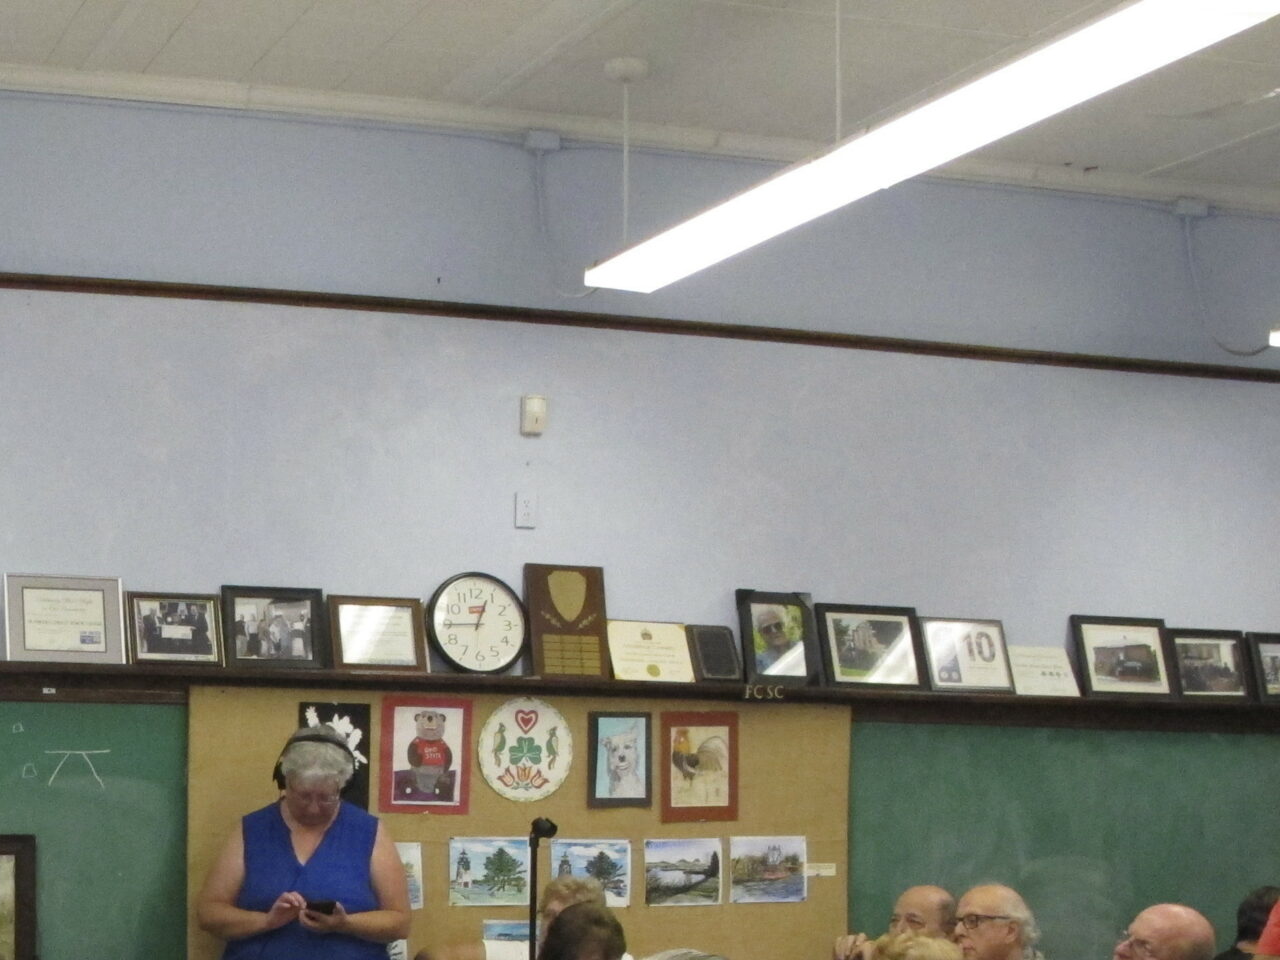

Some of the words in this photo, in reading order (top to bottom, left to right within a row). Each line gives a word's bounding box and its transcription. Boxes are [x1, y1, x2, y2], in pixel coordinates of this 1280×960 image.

[457, 592, 466, 603] 11
[469, 588, 483, 600] 12
[446, 603, 461, 615] 10
[498, 605, 506, 616] 2
[504, 620, 512, 631] 3
[447, 633, 458, 645] 8
[500, 635, 509, 646] 4
[460, 645, 469, 656] 7
[490, 646, 500, 657] 5
[961, 631, 996, 663] 10
[475, 650, 486, 661] 6
